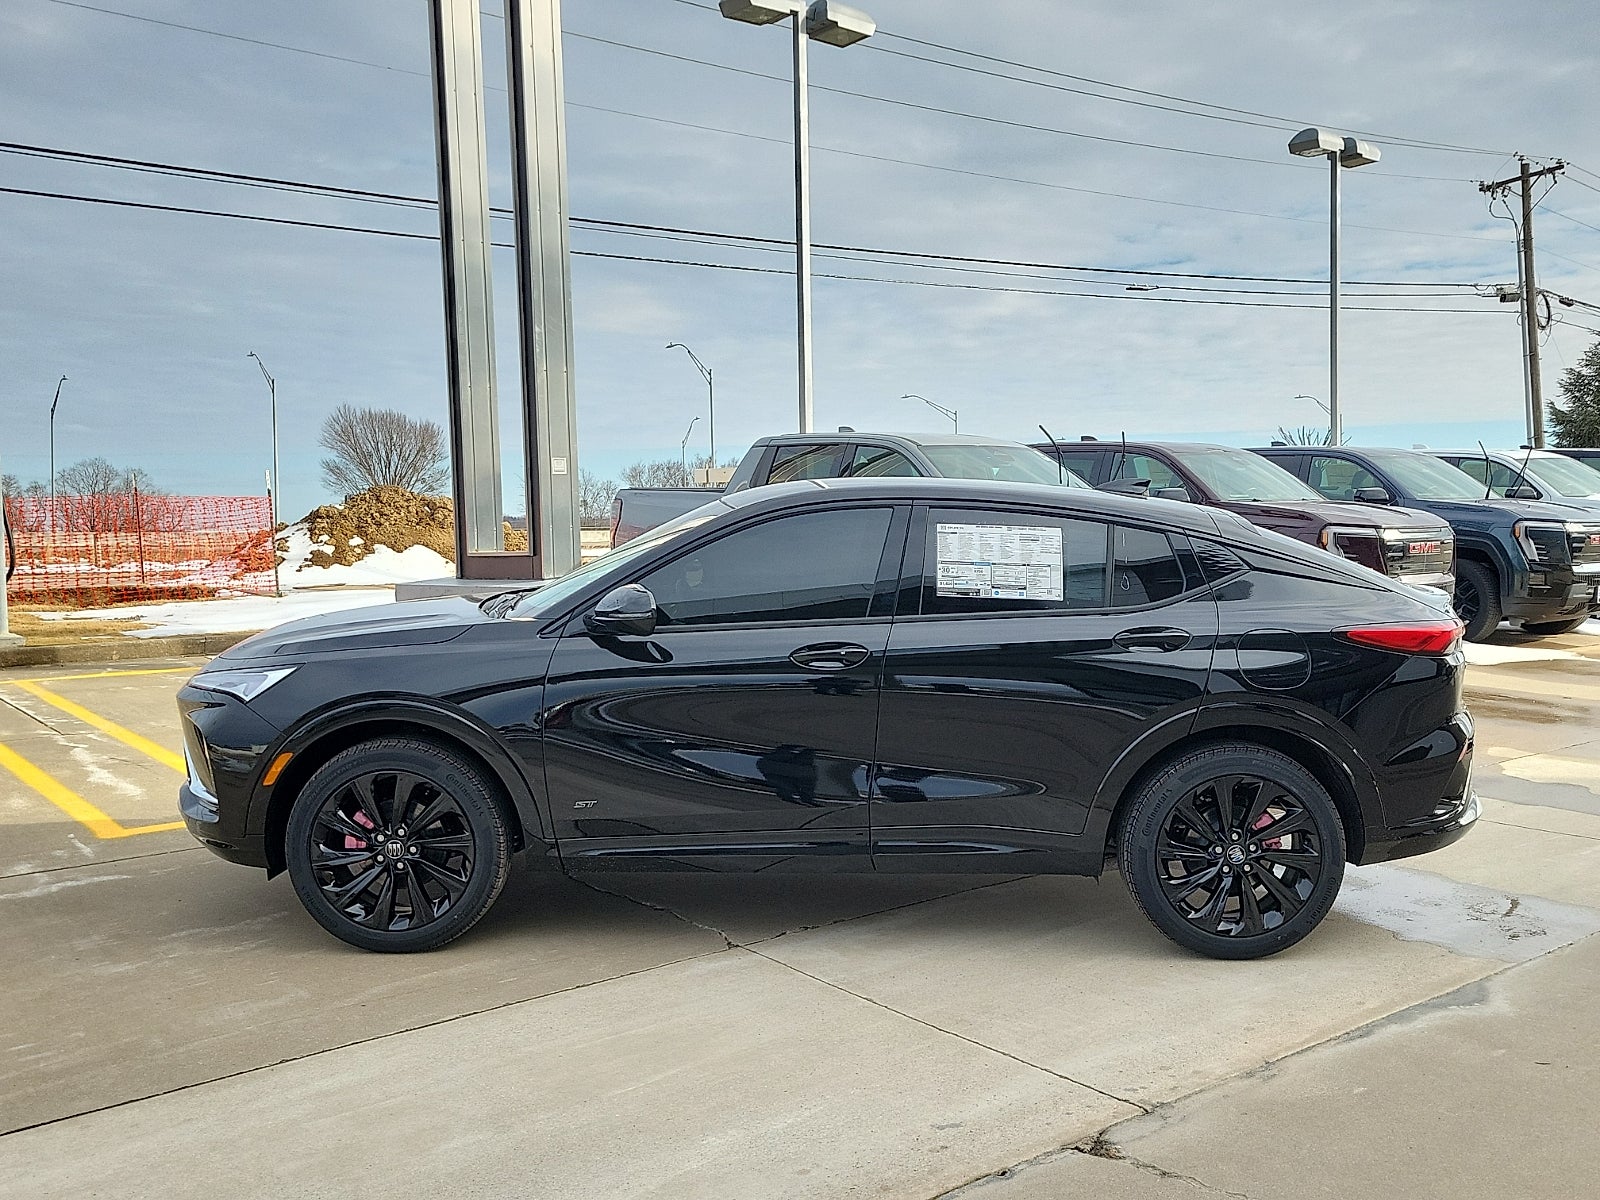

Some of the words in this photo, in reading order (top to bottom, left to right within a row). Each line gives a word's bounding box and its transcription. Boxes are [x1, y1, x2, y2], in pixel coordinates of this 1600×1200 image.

[1409, 541, 1441, 554] GMC
[573, 800, 598, 809] ST
[1142, 792, 1169, 836] Continental
